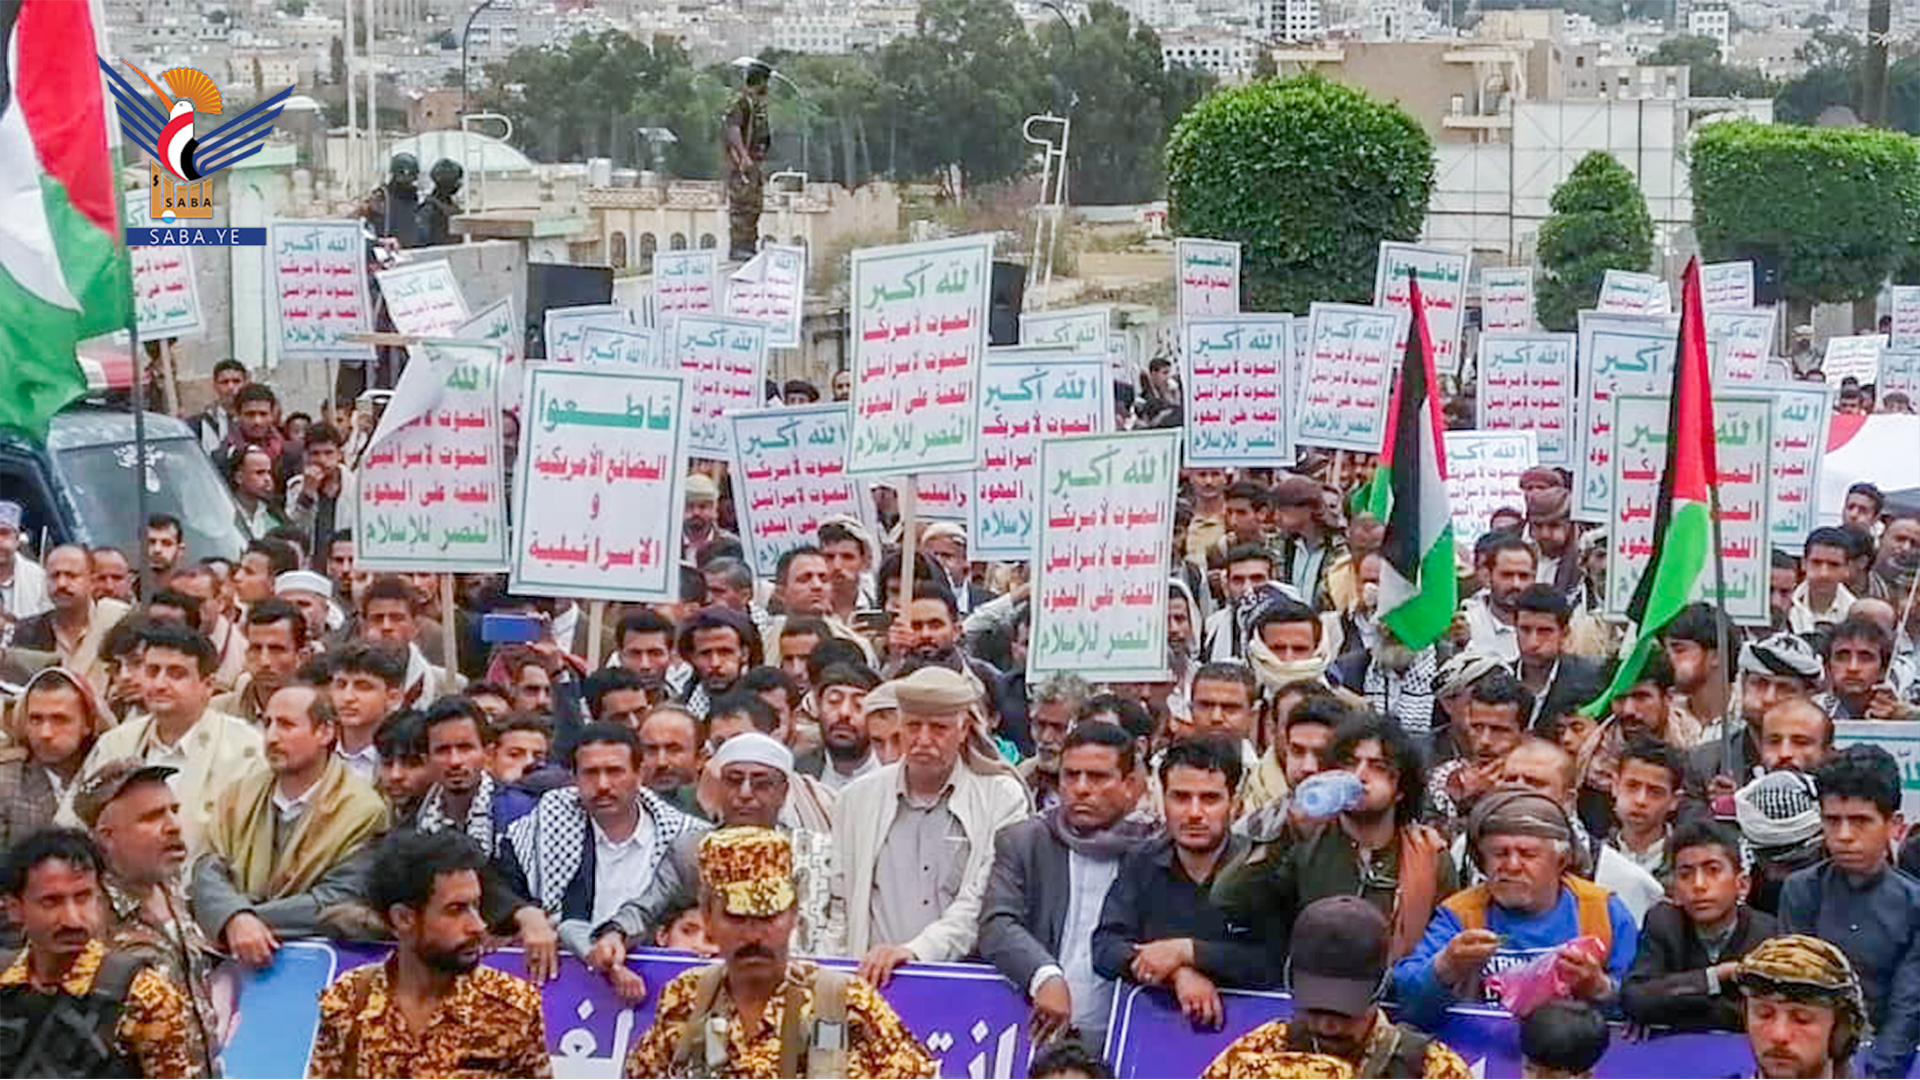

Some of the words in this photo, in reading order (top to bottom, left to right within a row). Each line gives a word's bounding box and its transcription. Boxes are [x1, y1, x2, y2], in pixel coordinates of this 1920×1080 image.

[863, 258, 935, 313] أكبر
[936, 259, 981, 294] الله
[862, 309, 921, 342] لأمريكا
[926, 306, 977, 337] الموت
[1194, 326, 1246, 357] أكبر
[1249, 328, 1281, 350] الله
[925, 344, 975, 373] الموت
[1594, 341, 1665, 379] أكبر
[446, 364, 491, 390] الله
[936, 379, 973, 405] اللعنة
[984, 367, 1049, 411] أكبر
[1053, 371, 1097, 399] الله
[538, 389, 671, 432] قاطعوا
[858, 388, 900, 420] اليهود
[904, 385, 928, 415] على
[1782, 397, 1819, 422] الله
[440, 407, 491, 431] الموت
[808, 424, 846, 445] الله
[918, 412, 972, 457] النصر
[1047, 412, 1097, 436] الموت
[742, 418, 803, 459] أكبر
[854, 419, 914, 463] للإسلام
[440, 443, 494, 469] الموت
[535, 442, 601, 482] الأمريكية
[606, 448, 666, 483] البضائع
[744, 455, 800, 482] لأمريكا
[804, 456, 844, 478] لموت
[1123, 448, 1168, 485] الله
[1052, 443, 1122, 501] أكبر
[364, 481, 412, 506] اليهود
[454, 480, 495, 502] اللعنة
[590, 493, 599, 519] و
[809, 483, 854, 507] الموت
[980, 480, 1024, 504] اليهود
[754, 516, 793, 538] اليهود
[1048, 497, 1109, 532] لأمريكا
[1113, 501, 1165, 530] الموت
[441, 512, 496, 551] النصر
[528, 530, 660, 570] الإسرائيلية
[1111, 540, 1163, 571] الموت
[1043, 582, 1085, 614] اليهود
[1089, 583, 1114, 613] على
[1120, 580, 1161, 606] اللعنة
[1039, 620, 1100, 664] للإسلام
[1105, 615, 1159, 661] النصر
